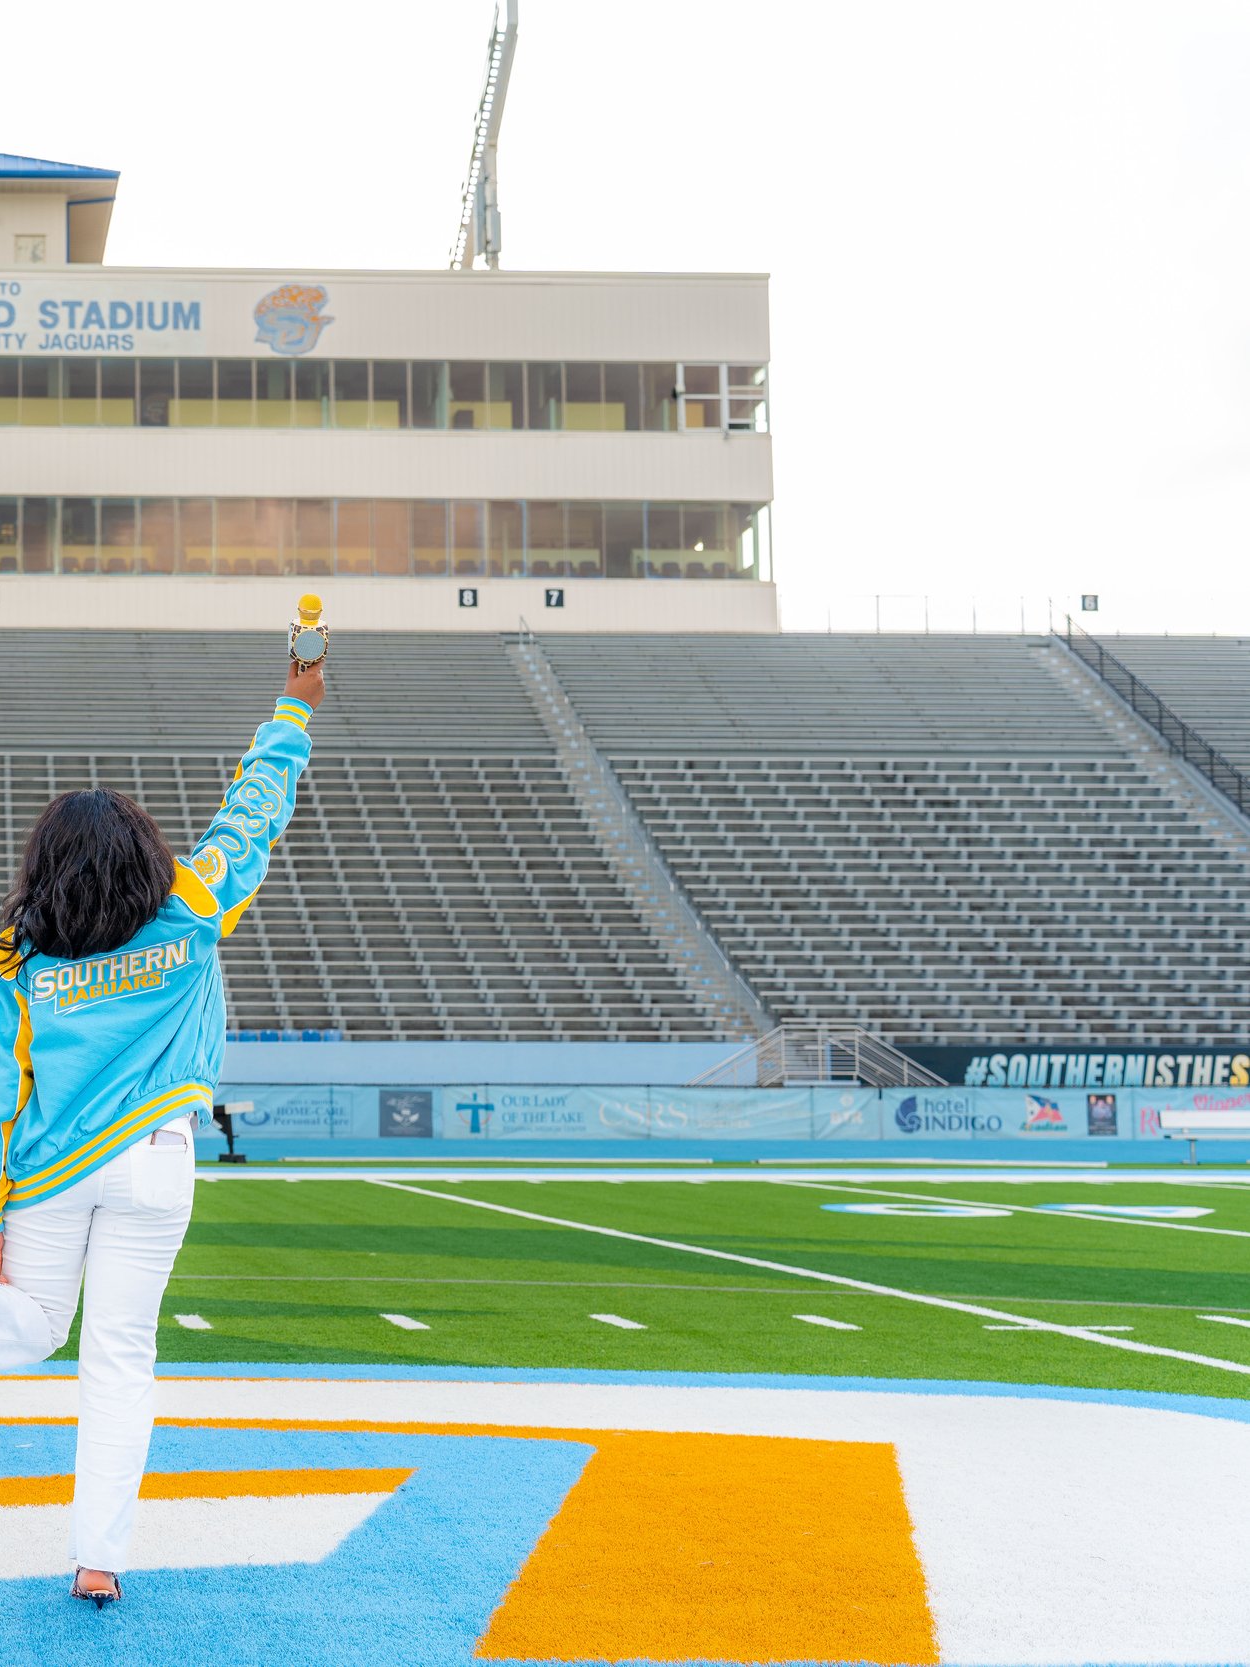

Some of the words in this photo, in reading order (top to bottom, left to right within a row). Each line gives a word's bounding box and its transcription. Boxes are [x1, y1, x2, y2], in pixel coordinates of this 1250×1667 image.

[0, 282, 21, 296] TO
[38, 300, 201, 331] STADIUM
[38, 333, 134, 351] JAGUARS
[462, 590, 474, 606] 8
[548, 590, 560, 606] 7
[34, 937, 189, 999] SOUTHERN
[59, 970, 162, 1008] JAGUARS
[501, 1094, 530, 1107] OUR
[533, 1094, 568, 1107] LADY
[923, 1098, 969, 1113] hotel
[273, 1117, 321, 1126] Personal
[501, 1111, 517, 1123] OF
[521, 1111, 547, 1123] THE
[550, 1110, 584, 1123] LAKE
[924, 1114, 1002, 1132] INDIGO
